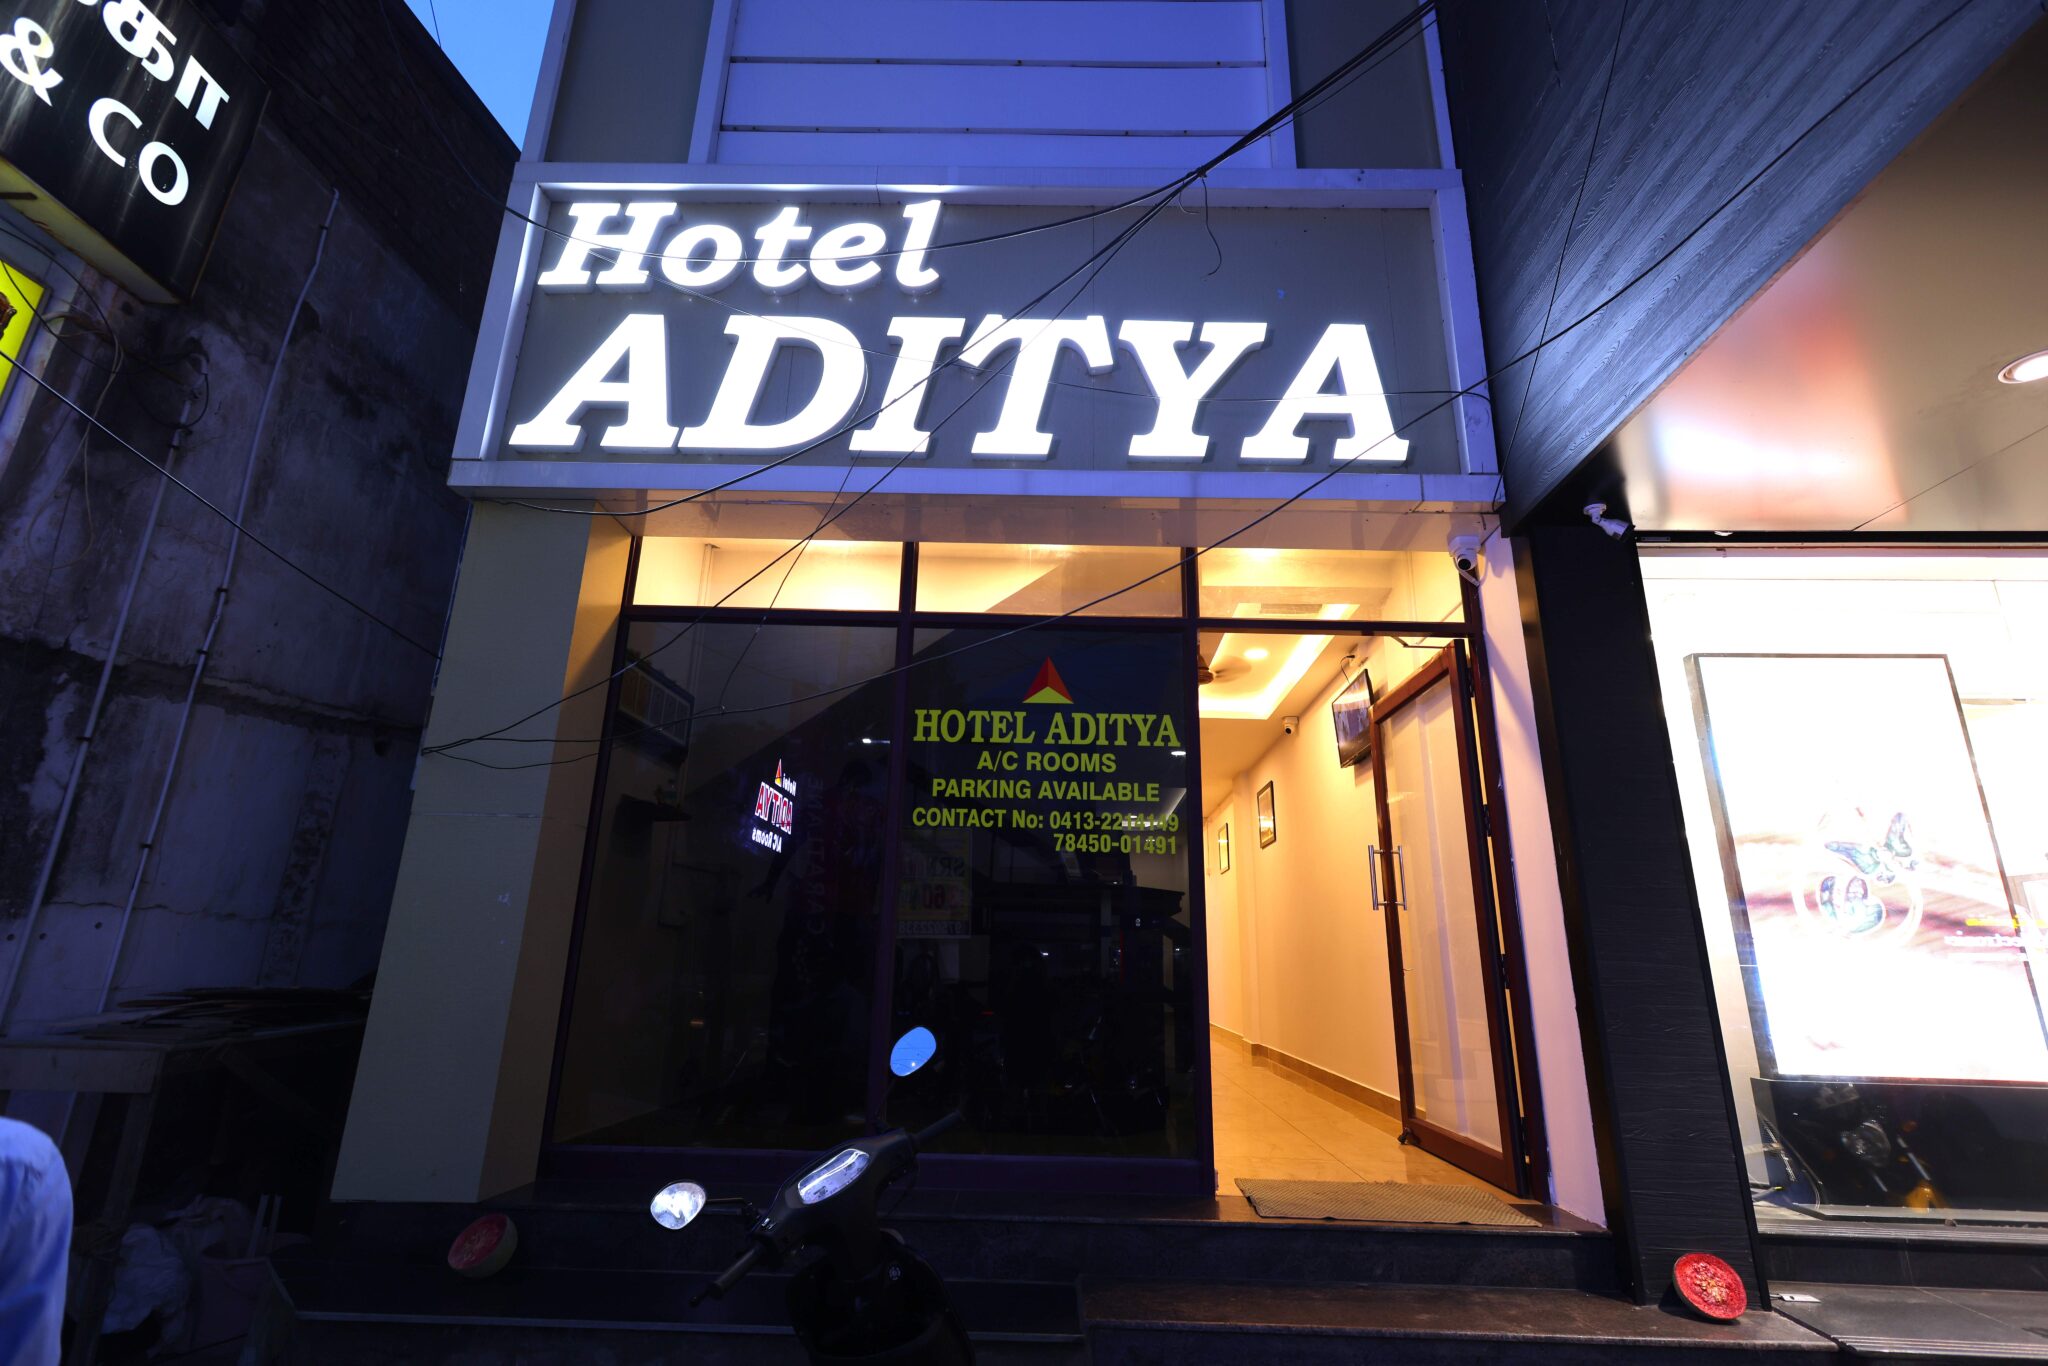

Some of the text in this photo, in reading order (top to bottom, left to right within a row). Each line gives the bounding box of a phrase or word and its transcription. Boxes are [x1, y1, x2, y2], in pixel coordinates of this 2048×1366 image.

[537, 199, 942, 291] Hotel
[508, 313, 1411, 463] ADITYA
[913, 709, 1181, 747] HOTEL ADITYA
[977, 751, 1117, 773] A/C ROOMS
[932, 778, 1160, 802] PARKING AVAILABLE
[912, 807, 1006, 828] CONTACT
[1012, 809, 1044, 829] No:
[1054, 833, 1177, 855] 78450-01491
